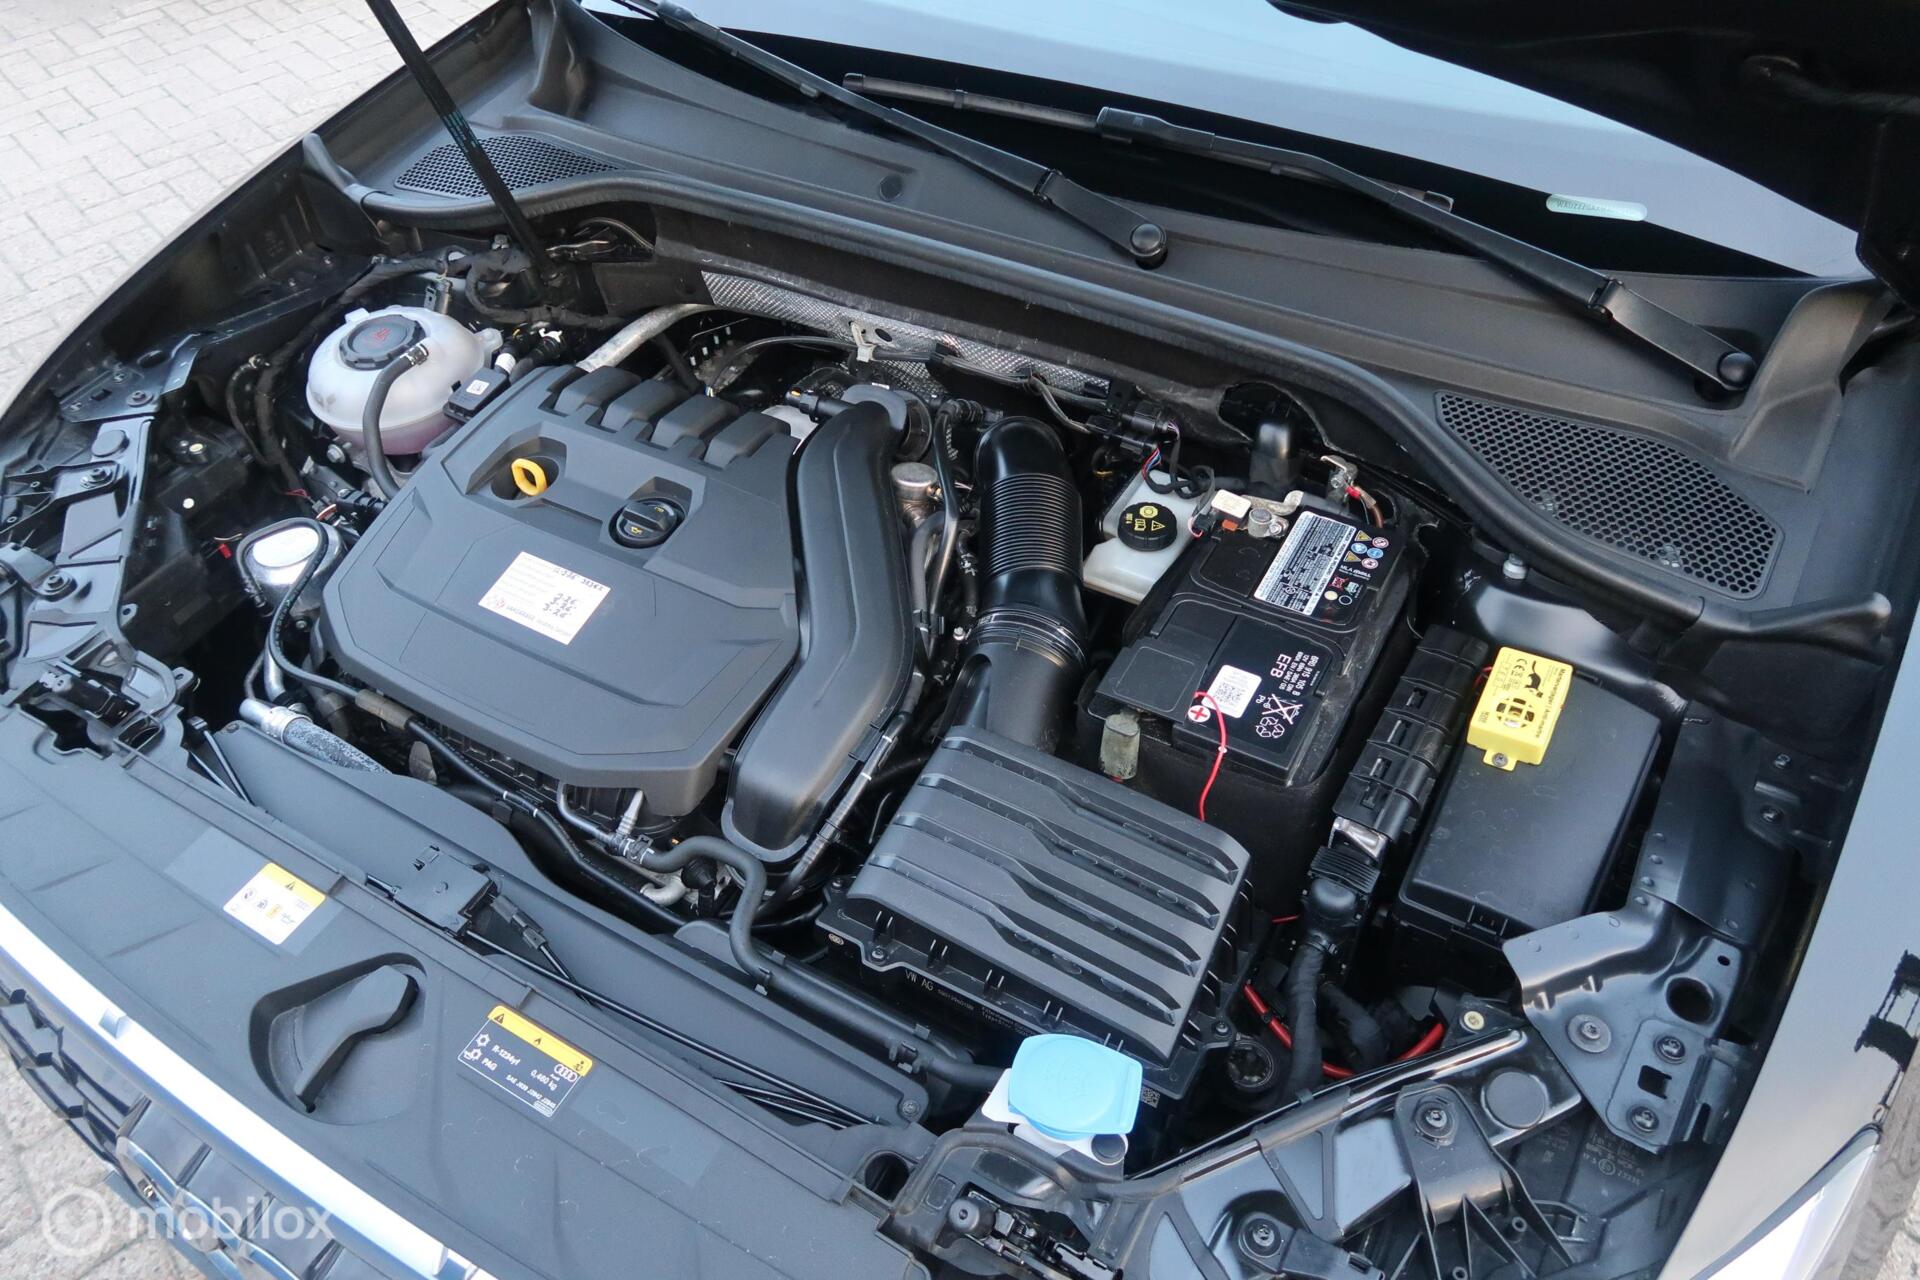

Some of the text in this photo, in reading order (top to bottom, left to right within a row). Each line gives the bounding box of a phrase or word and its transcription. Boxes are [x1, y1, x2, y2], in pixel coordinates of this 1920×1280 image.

[1270, 654, 1291, 678] EFB
[1302, 666, 1312, 678] 915
[1296, 680, 1306, 690] 105
[904, 969, 934, 991] VW AG
[482, 1057, 497, 1071] PAG
[492, 1044, 521, 1066] R-1234yf
[548, 1081, 558, 1091] kg
